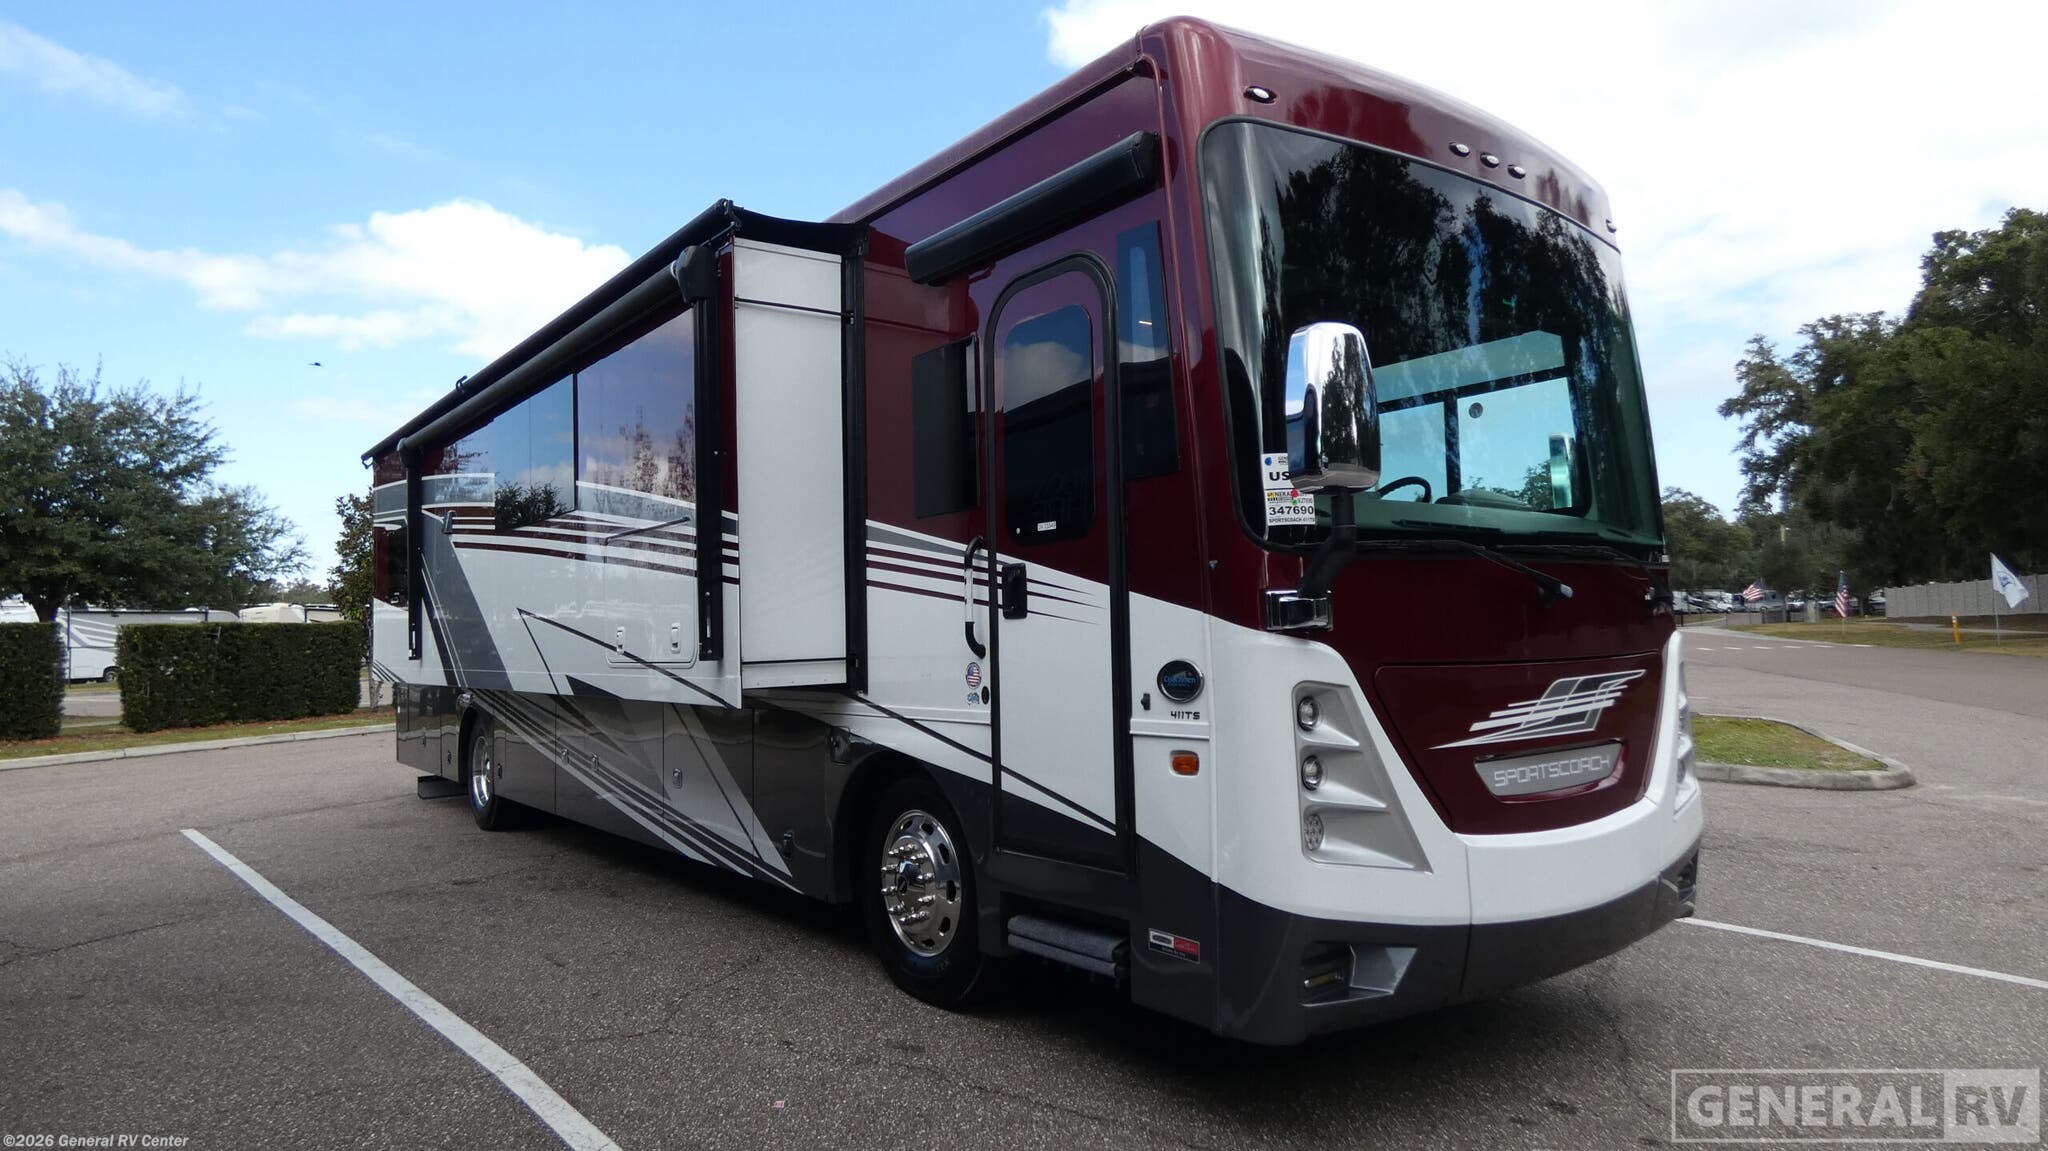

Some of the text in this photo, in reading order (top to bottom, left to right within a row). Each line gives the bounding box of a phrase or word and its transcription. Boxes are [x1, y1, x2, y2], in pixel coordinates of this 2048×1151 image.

[1269, 506, 1314, 516] 347690
[1170, 710, 1201, 720] 411TS
[1494, 755, 1610, 787] SPORTSCOACH
